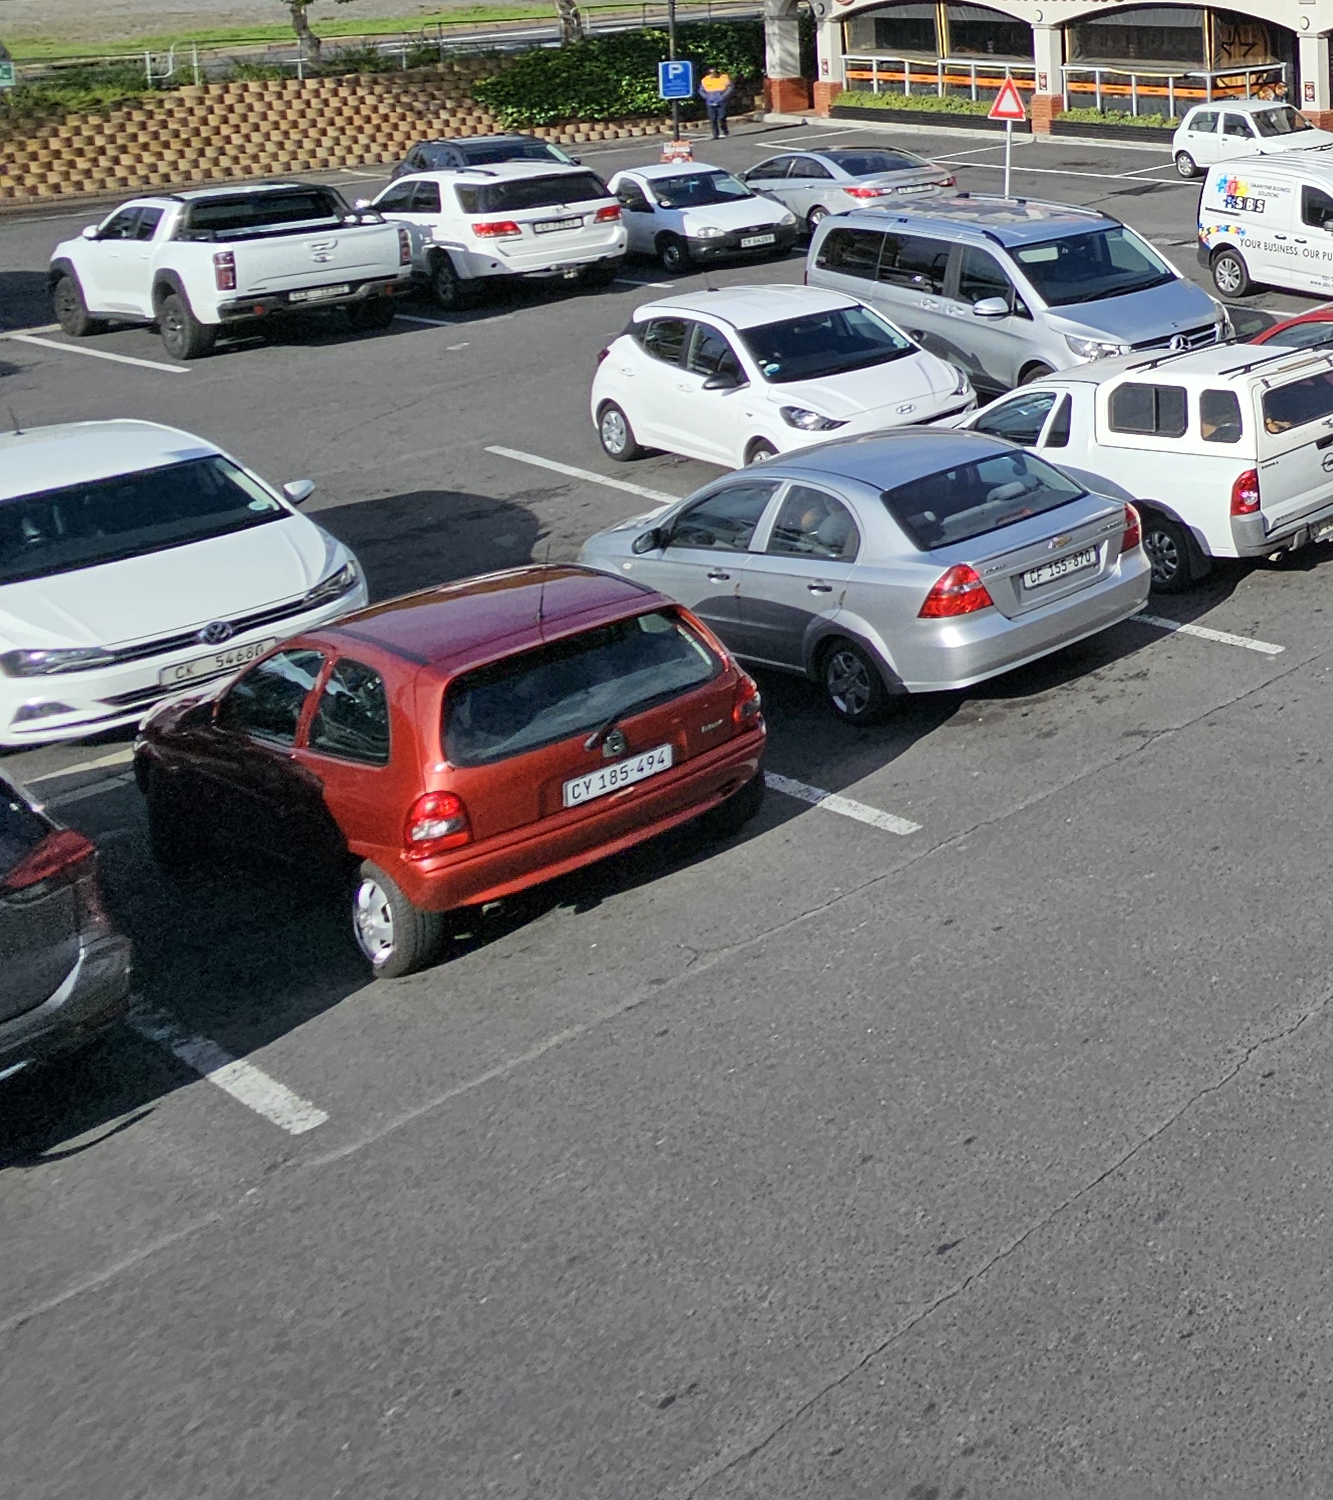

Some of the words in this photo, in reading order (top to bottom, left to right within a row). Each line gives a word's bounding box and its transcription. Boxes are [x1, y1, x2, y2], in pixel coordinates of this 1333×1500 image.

[668, 64, 684, 79] P
[1236, 197, 1264, 212] SBS
[1240, 238, 1262, 249] YOUR
[1302, 248, 1320, 259] OUR
[1030, 570, 1043, 583] CF
[1049, 550, 1091, 577] 155-870
[175, 663, 195, 679] CK
[572, 778, 593, 800] CY
[598, 750, 666, 790] 185-494
